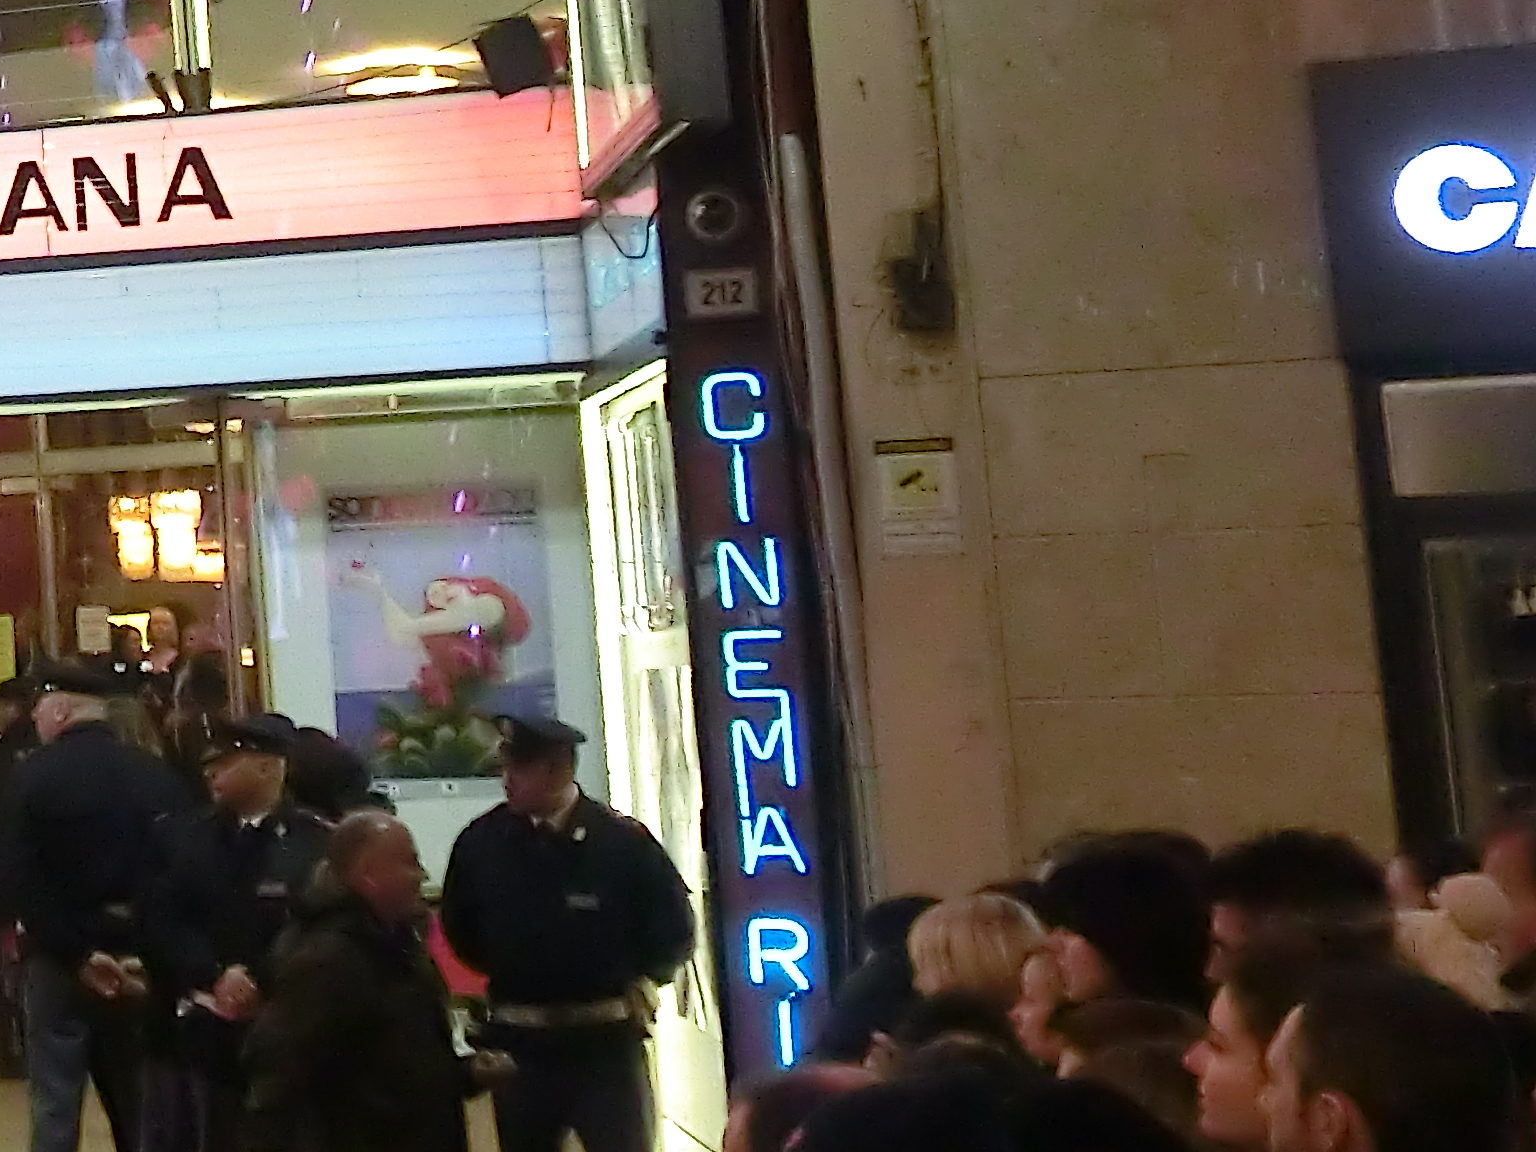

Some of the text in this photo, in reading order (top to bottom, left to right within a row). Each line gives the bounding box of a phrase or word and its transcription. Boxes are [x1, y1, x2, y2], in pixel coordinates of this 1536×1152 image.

[1391, 142, 1536, 255] C
[702, 280, 744, 305] 212
[700, 371, 806, 876] CINEMA
